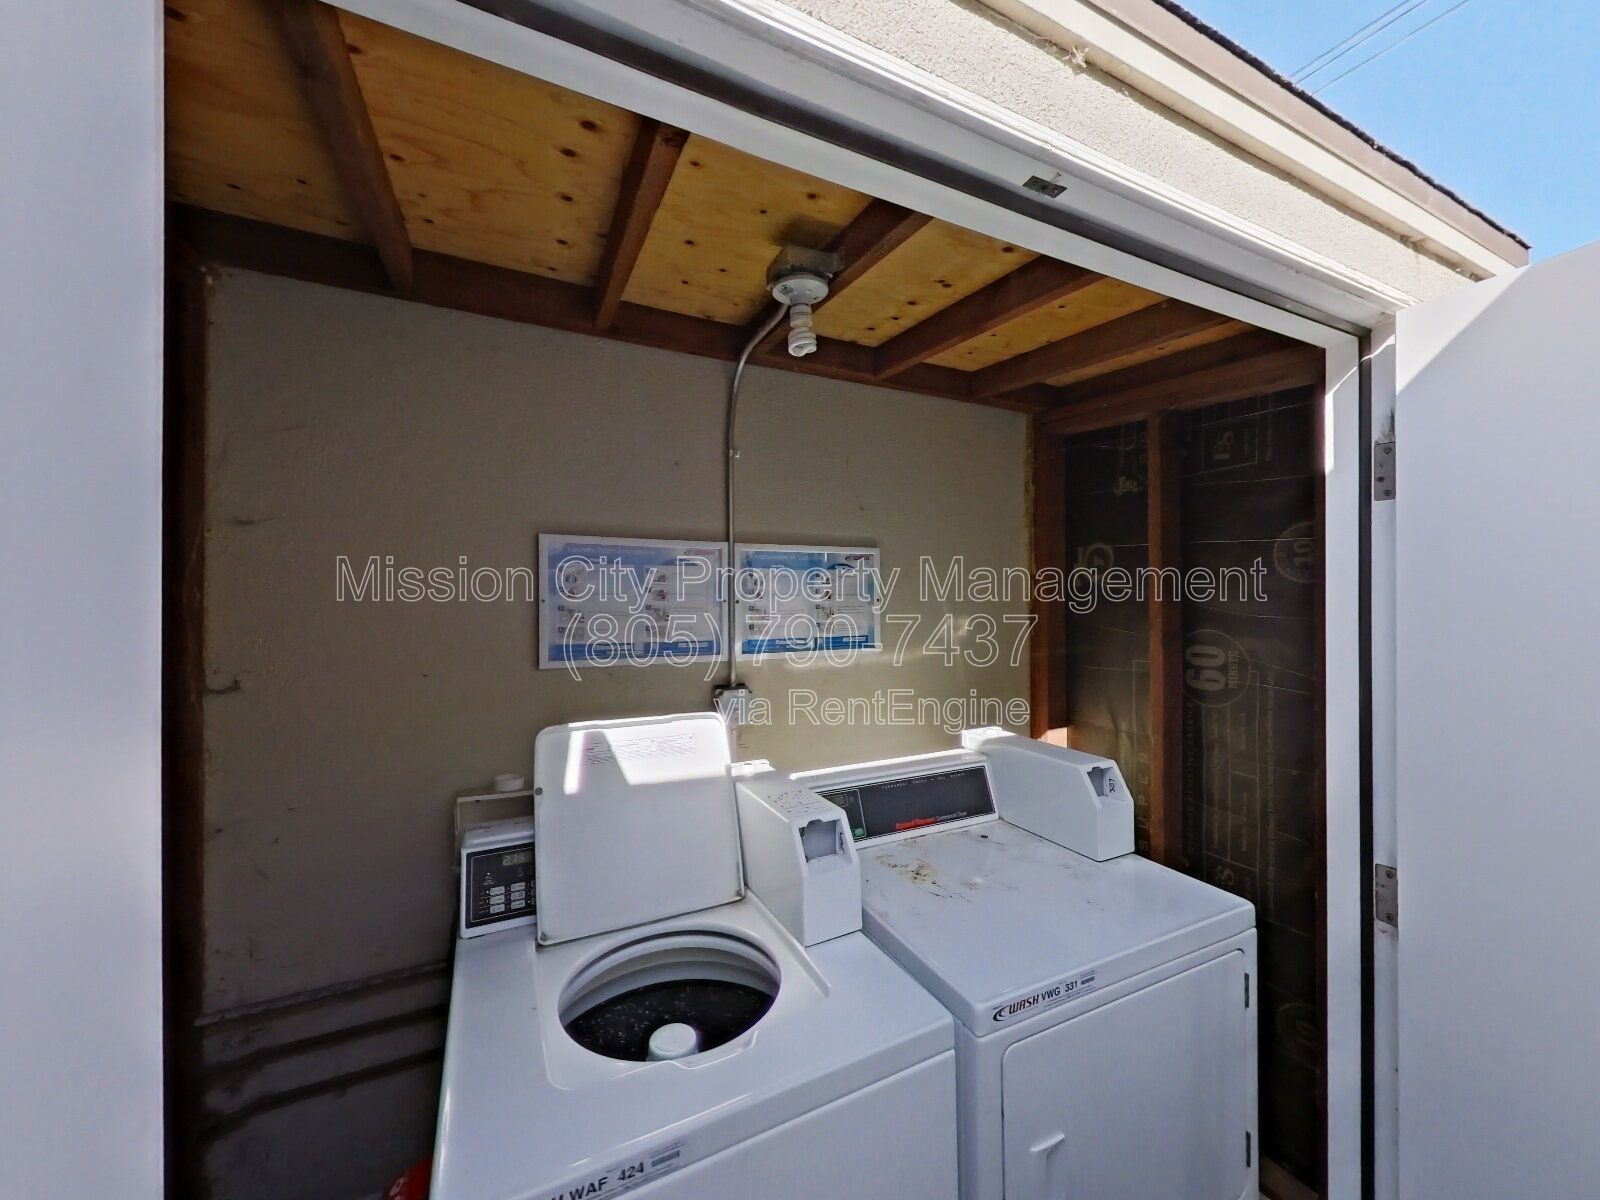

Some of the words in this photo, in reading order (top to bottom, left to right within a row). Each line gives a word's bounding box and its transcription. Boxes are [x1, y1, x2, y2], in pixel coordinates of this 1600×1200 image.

[1185, 645, 1225, 691] 60
[1008, 994, 1040, 1015] WASH
[1041, 986, 1061, 1001] VWG
[1064, 980, 1079, 992] 331
[569, 1176, 608, 1200] WAF
[617, 1161, 645, 1181] 424
